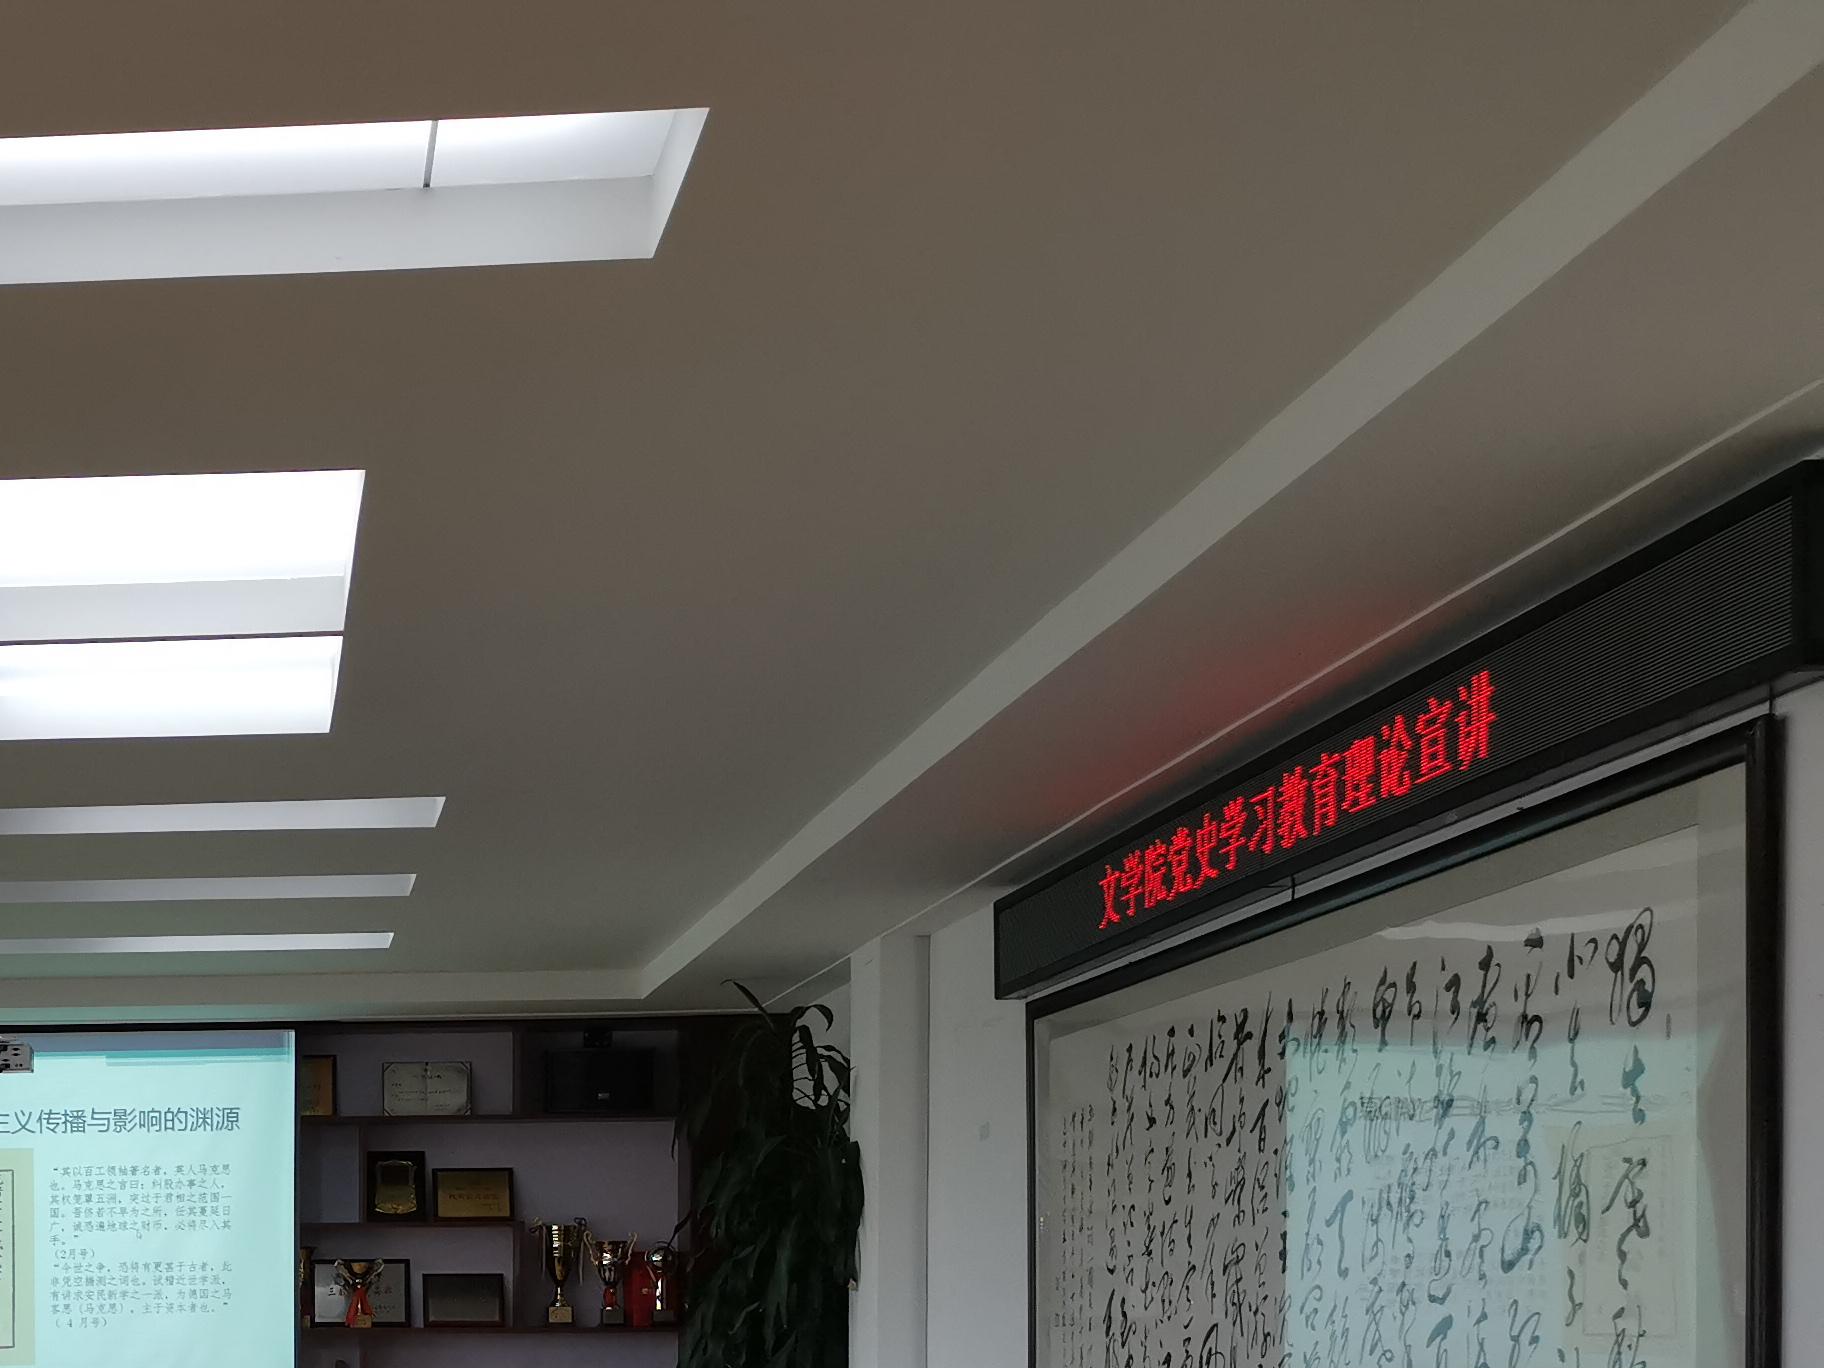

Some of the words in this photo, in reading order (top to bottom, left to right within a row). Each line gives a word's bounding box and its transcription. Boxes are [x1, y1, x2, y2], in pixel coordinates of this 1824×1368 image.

[1098, 670, 1497, 930] 文学院党史学习教育理论宣讲
